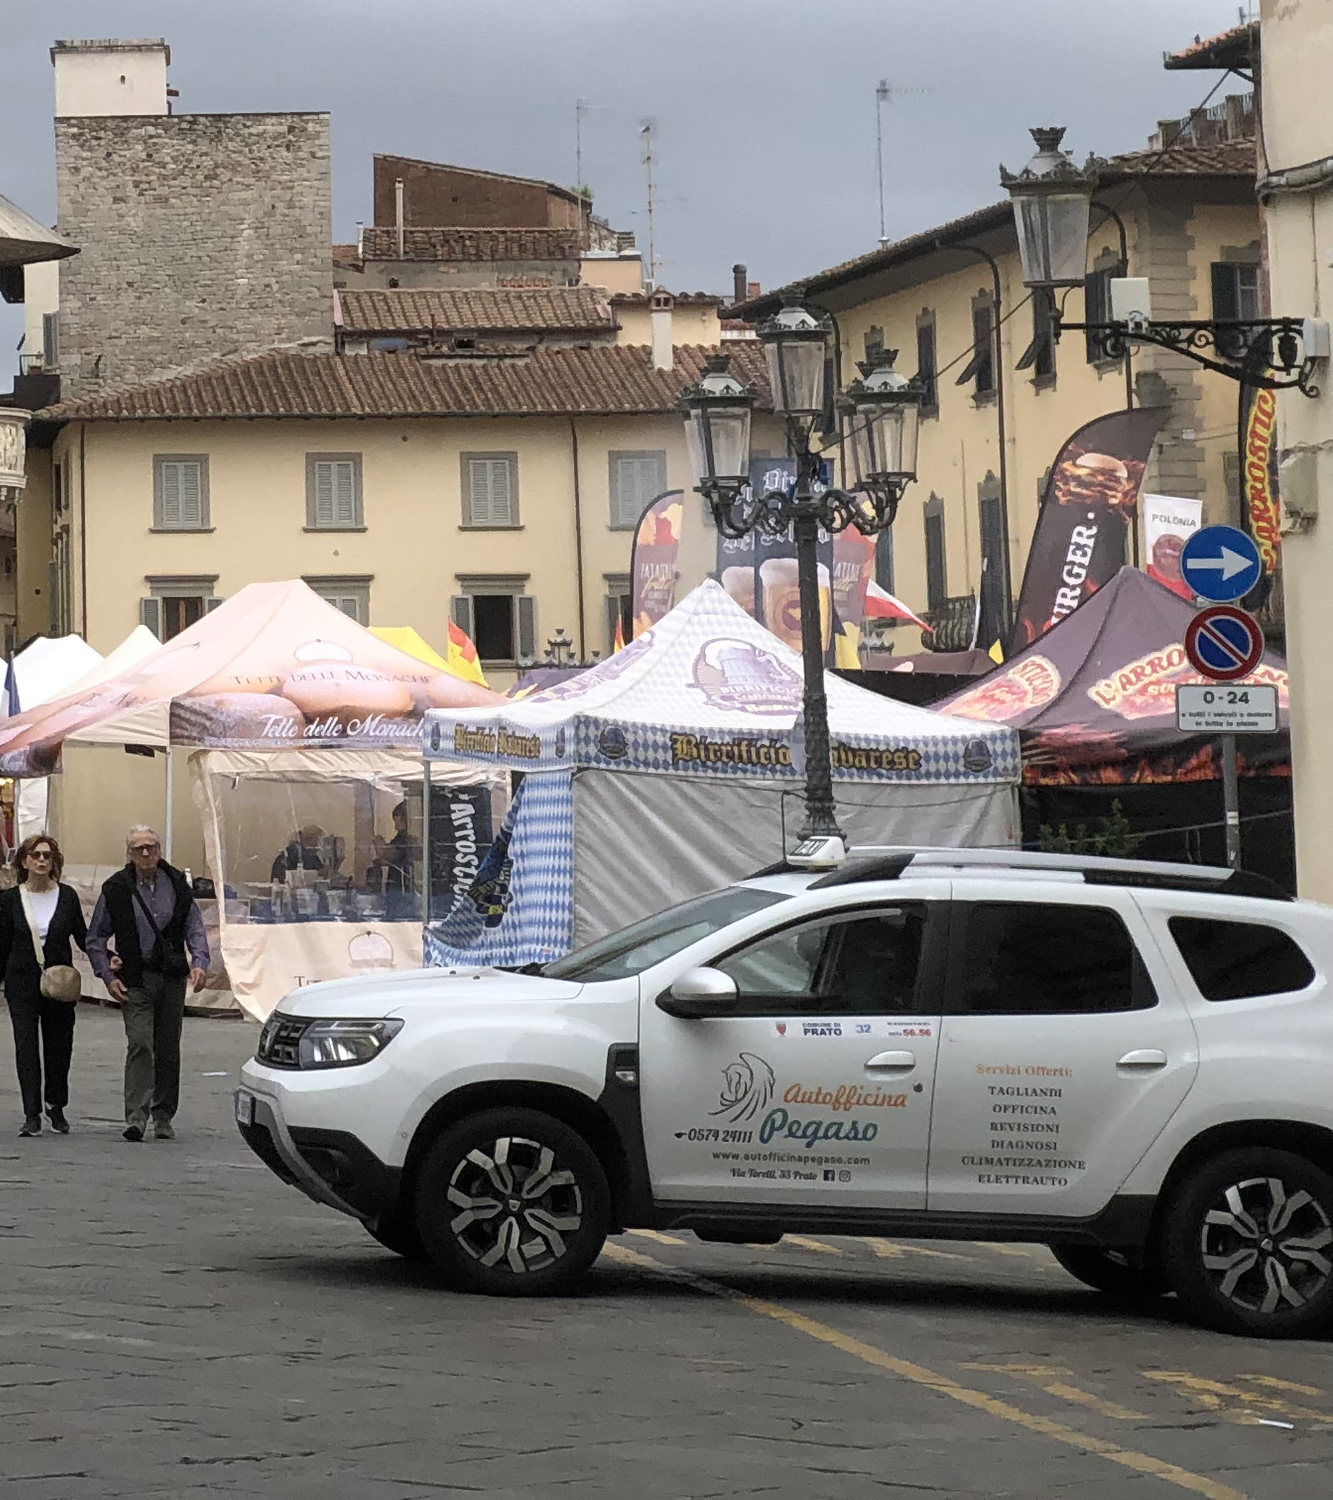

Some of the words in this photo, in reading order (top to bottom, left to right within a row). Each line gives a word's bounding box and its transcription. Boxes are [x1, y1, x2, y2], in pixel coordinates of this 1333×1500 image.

[1151, 513, 1197, 528] POLONIA
[259, 713, 298, 738] Tette
[303, 716, 342, 738] delle
[345, 713, 425, 738] Monach
[670, 732, 791, 767] Birrificio
[794, 839, 826, 855] TAXI
[803, 1028, 842, 1037] PRATO
[976, 1063, 1021, 1075] Servizi
[783, 1083, 908, 1111] Autofficina
[987, 1085, 1063, 1098] TAGLIANDI
[992, 1103, 1057, 1116] OFFICINA
[759, 1107, 879, 1148] Pegaso
[989, 1121, 1060, 1134] REVISIONI
[991, 1139, 1058, 1151] DIAGNOSI
[711, 1150, 871, 1167] www.autofficinapegaso.com
[961, 1155, 1086, 1170] CLIMATIZZAZIONE
[977, 1173, 1068, 1187] ELETTRAUTO
